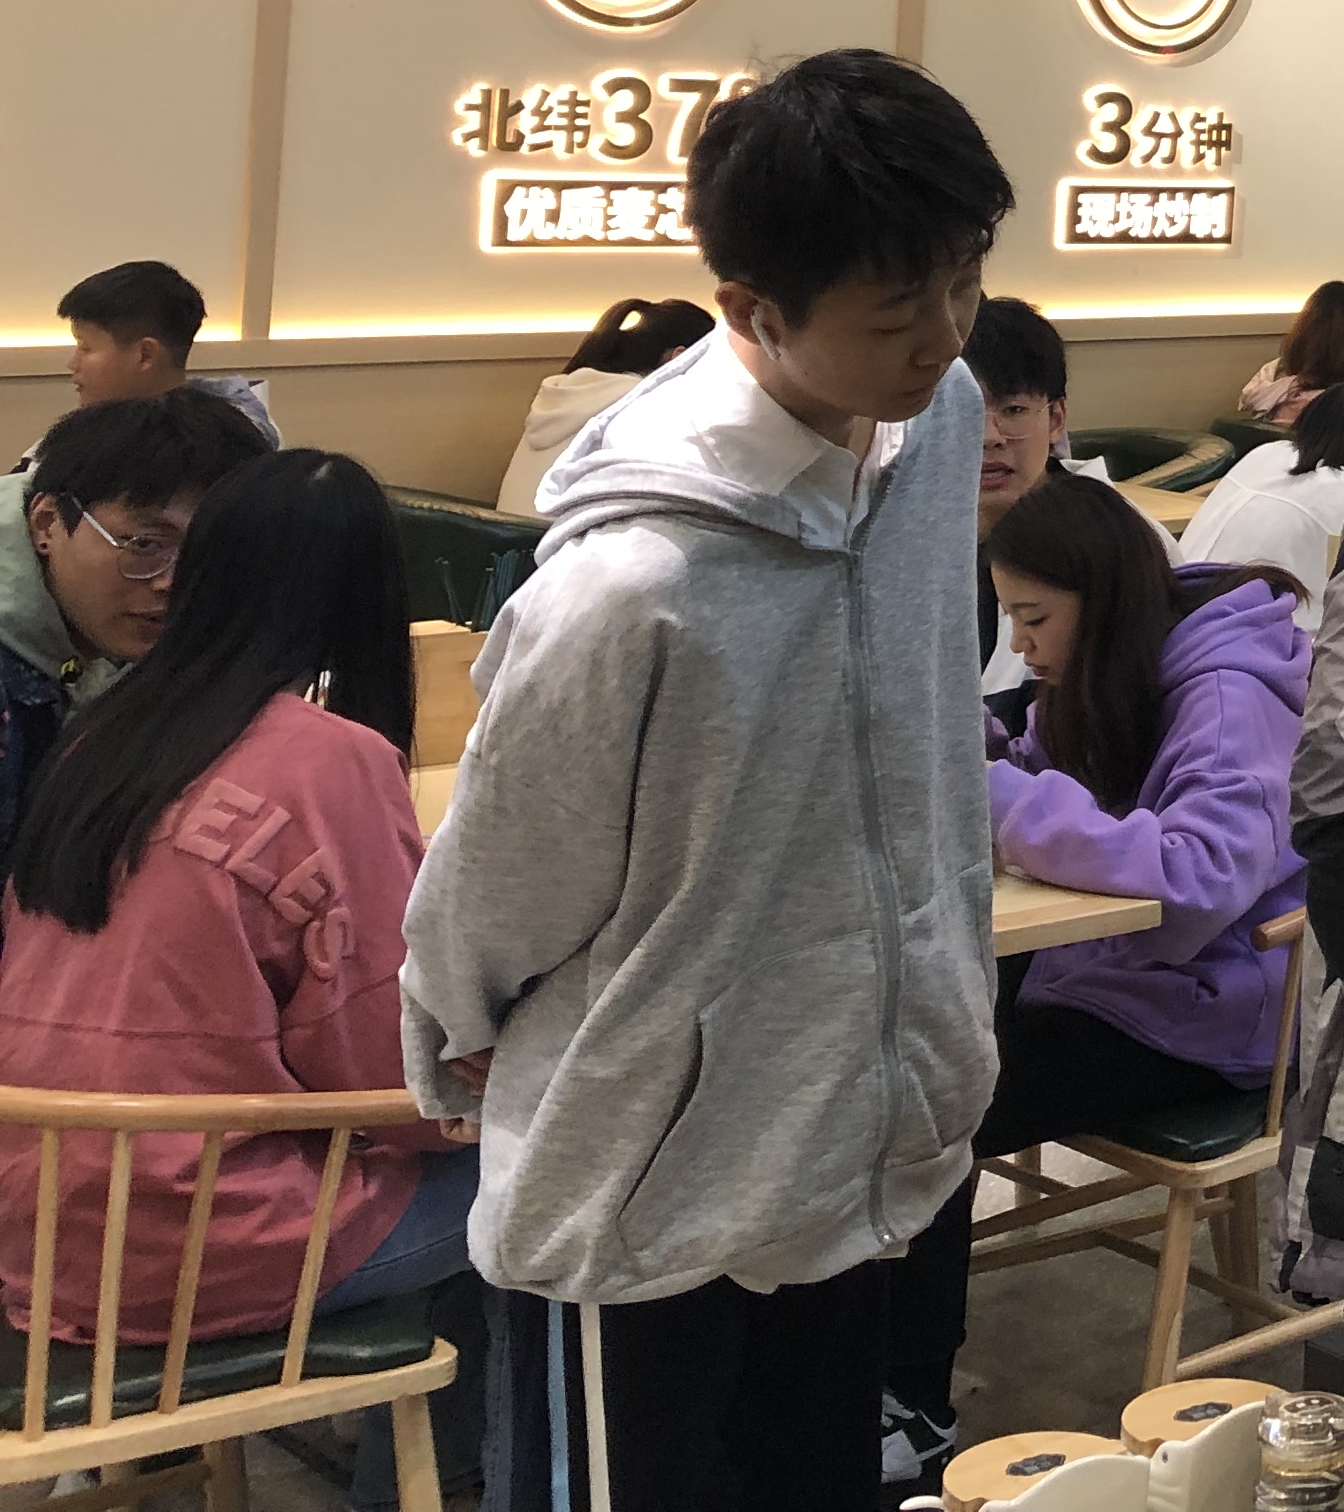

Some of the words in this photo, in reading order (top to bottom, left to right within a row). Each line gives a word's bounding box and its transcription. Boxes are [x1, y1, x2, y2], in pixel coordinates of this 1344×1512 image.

[1085, 91, 1234, 167] 3分钟
[1074, 192, 1228, 239] 现场炒制
[160, 777, 355, 981] ELES
